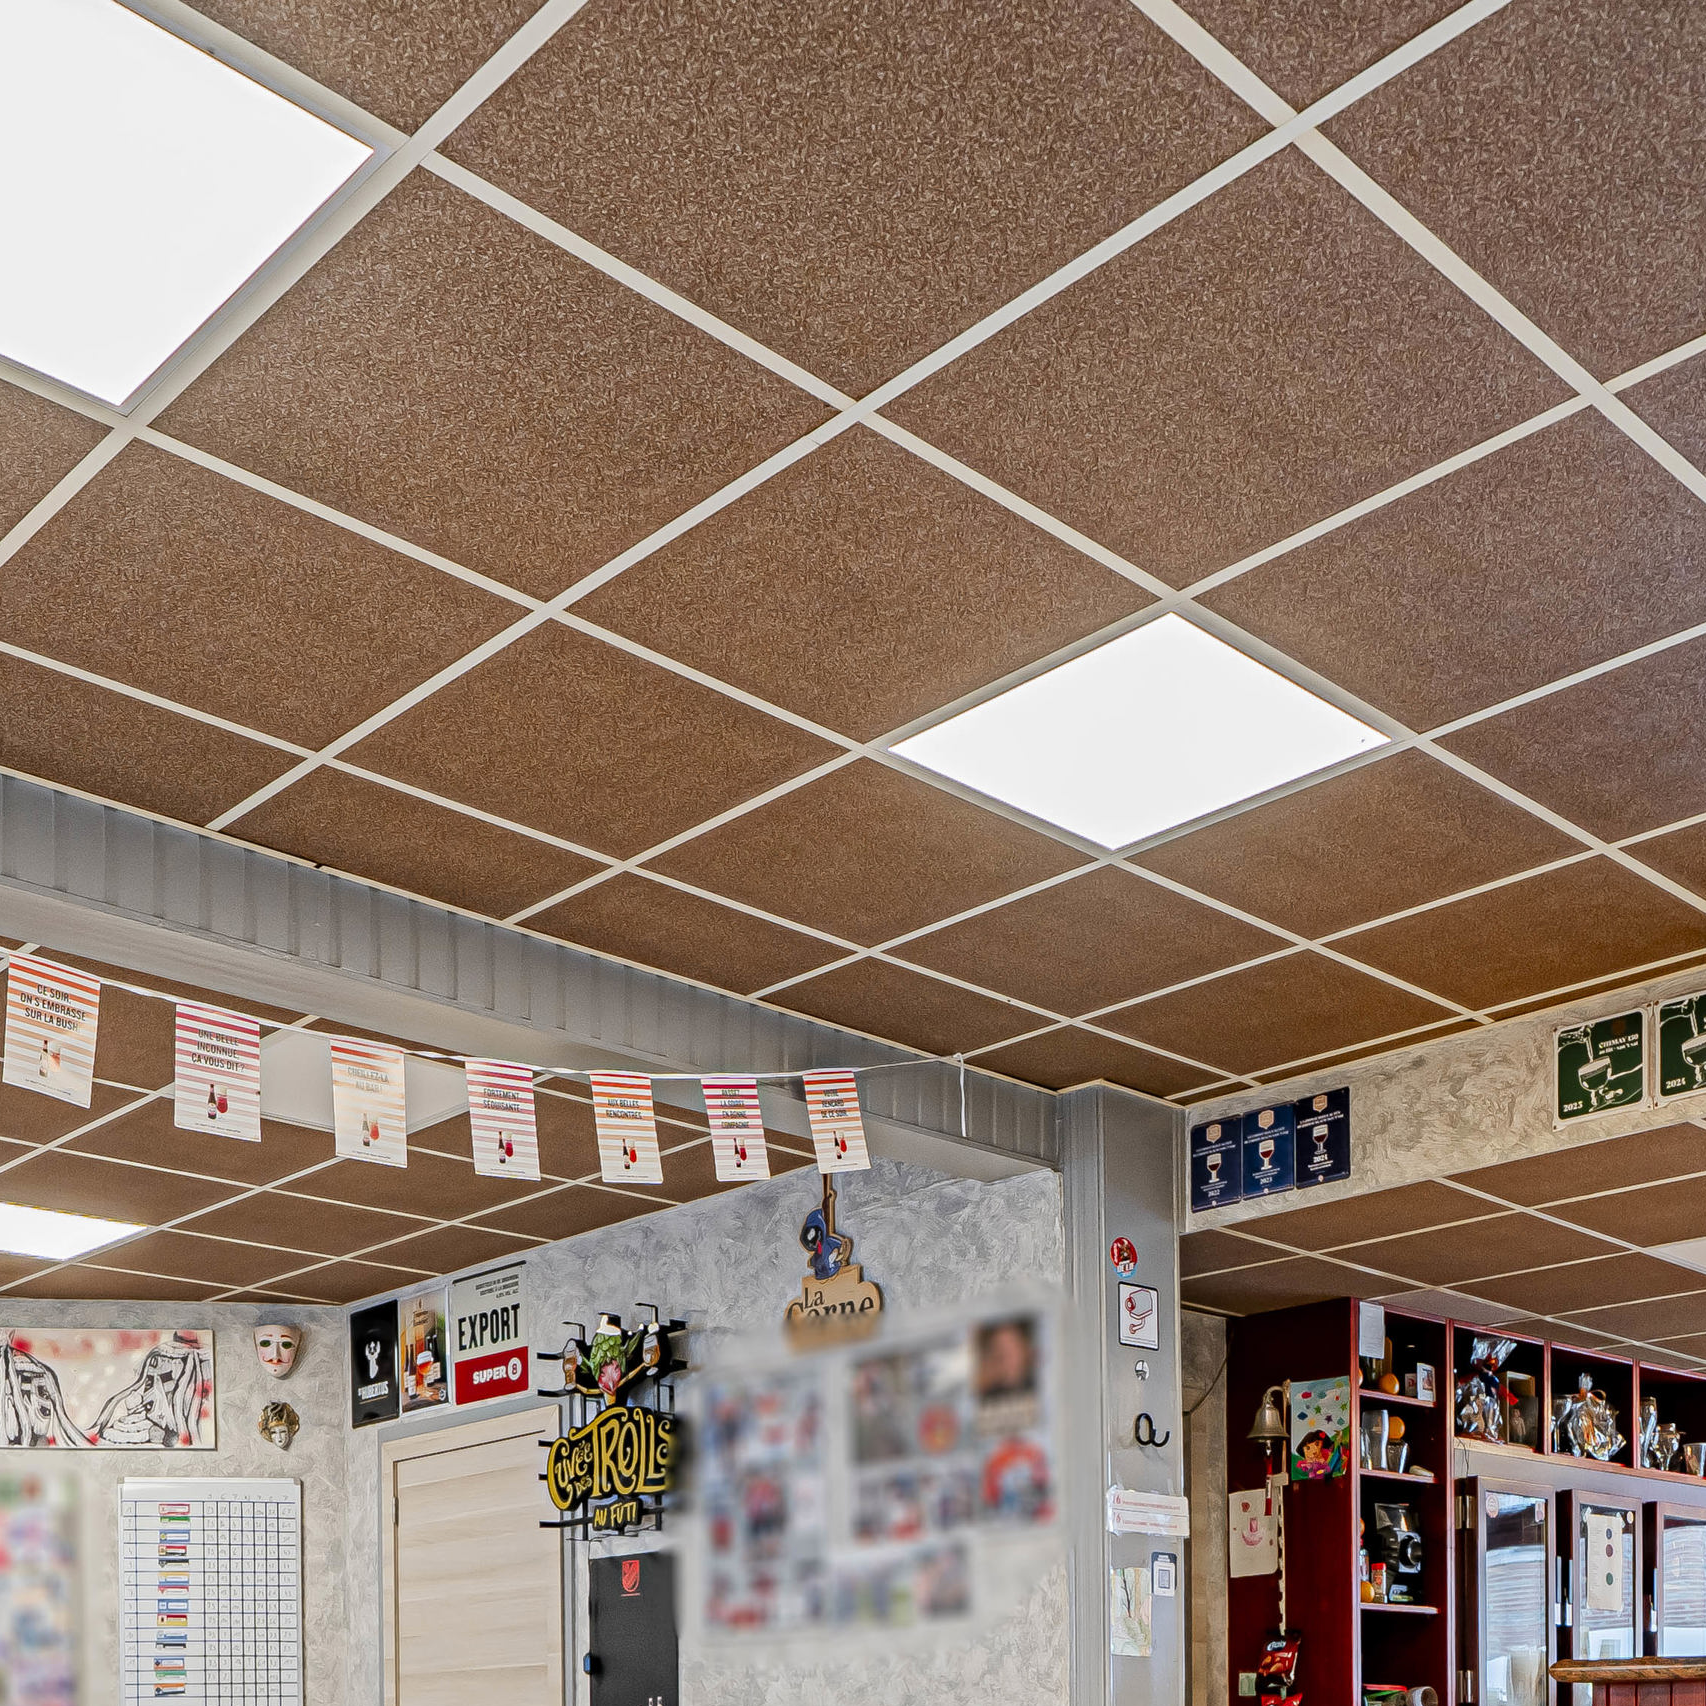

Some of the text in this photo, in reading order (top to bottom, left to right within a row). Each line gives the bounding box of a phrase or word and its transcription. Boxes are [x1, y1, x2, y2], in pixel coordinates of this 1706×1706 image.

[37, 984, 48, 996] CE
[20, 992, 32, 1004] ON
[24, 1007, 42, 1021] SUR
[44, 1013, 54, 1024] LA
[1598, 1036, 1627, 1049] CHIMAY
[203, 1055, 225, 1069] VOUS
[226, 1061, 239, 1073] DIT
[1665, 1077, 1686, 1089] 2024
[483, 1087, 521, 1101] FORTEMENT
[607, 1098, 640, 1109] AUX BELLES
[458, 1303, 520, 1351] EXPORT
[473, 1366, 506, 1385] SUPER
[568, 1406, 670, 1498] TROLLS
[594, 1508, 606, 1527] AU
